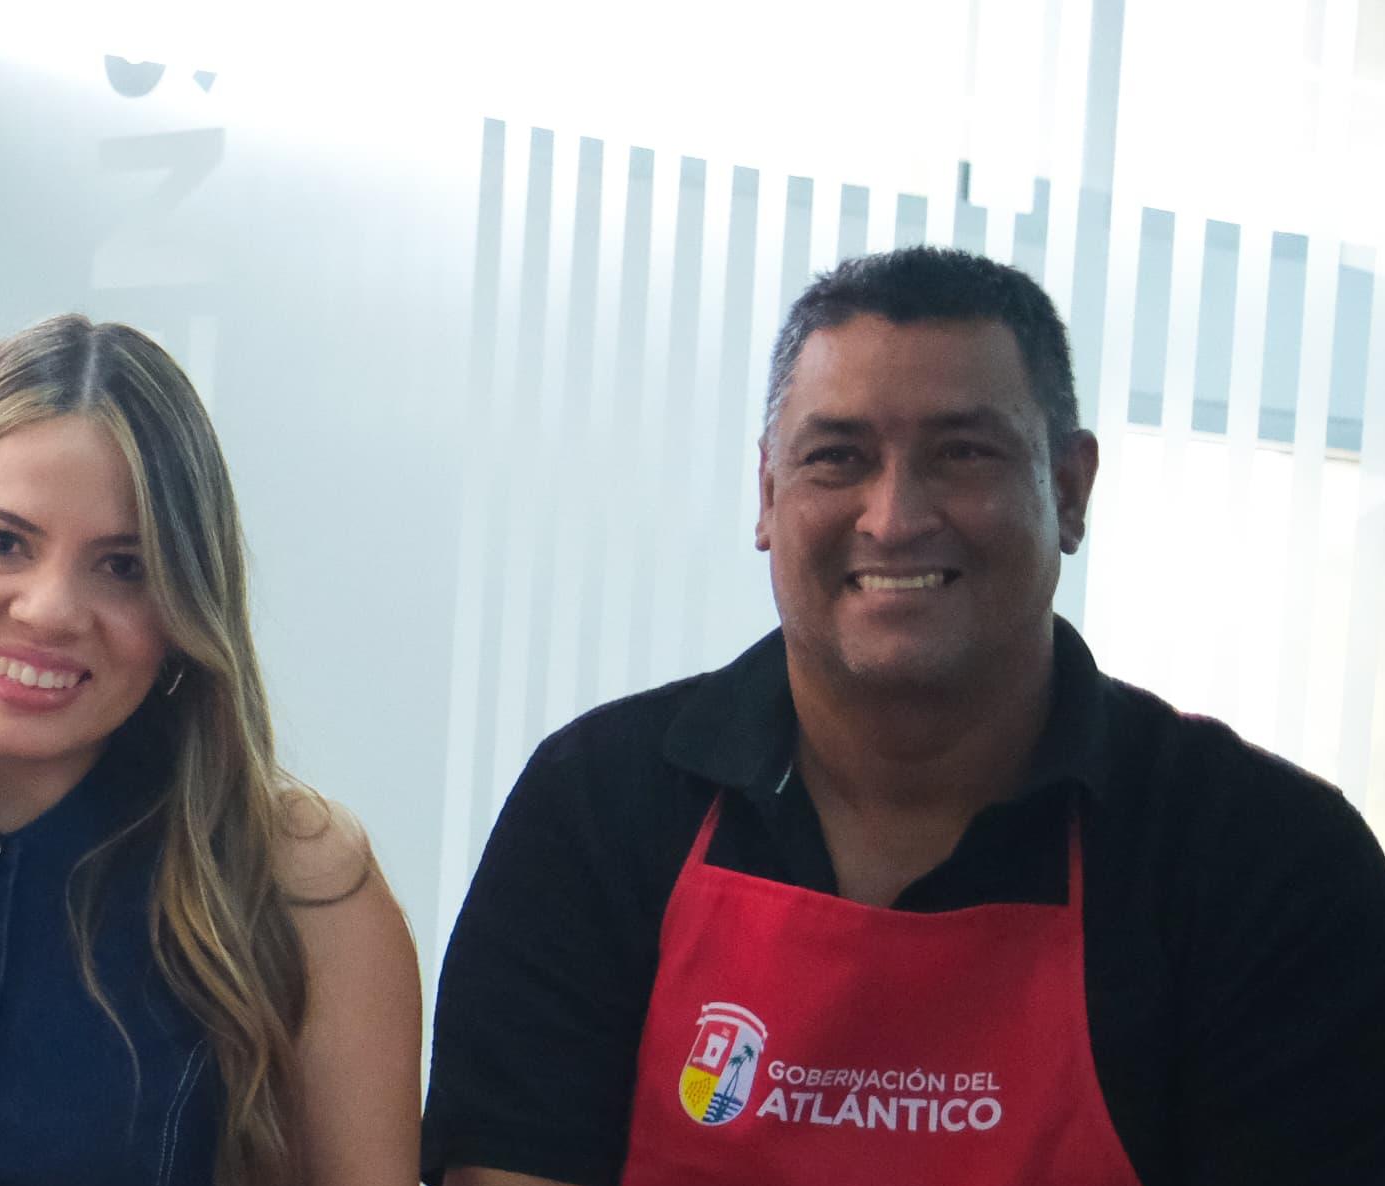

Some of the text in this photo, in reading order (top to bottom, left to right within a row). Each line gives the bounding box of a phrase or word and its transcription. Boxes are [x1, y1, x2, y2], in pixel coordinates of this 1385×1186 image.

[768, 1060, 1000, 1092] GOBERNACIÓN DEL
[756, 1085, 1002, 1132] ATLÁNTICO
